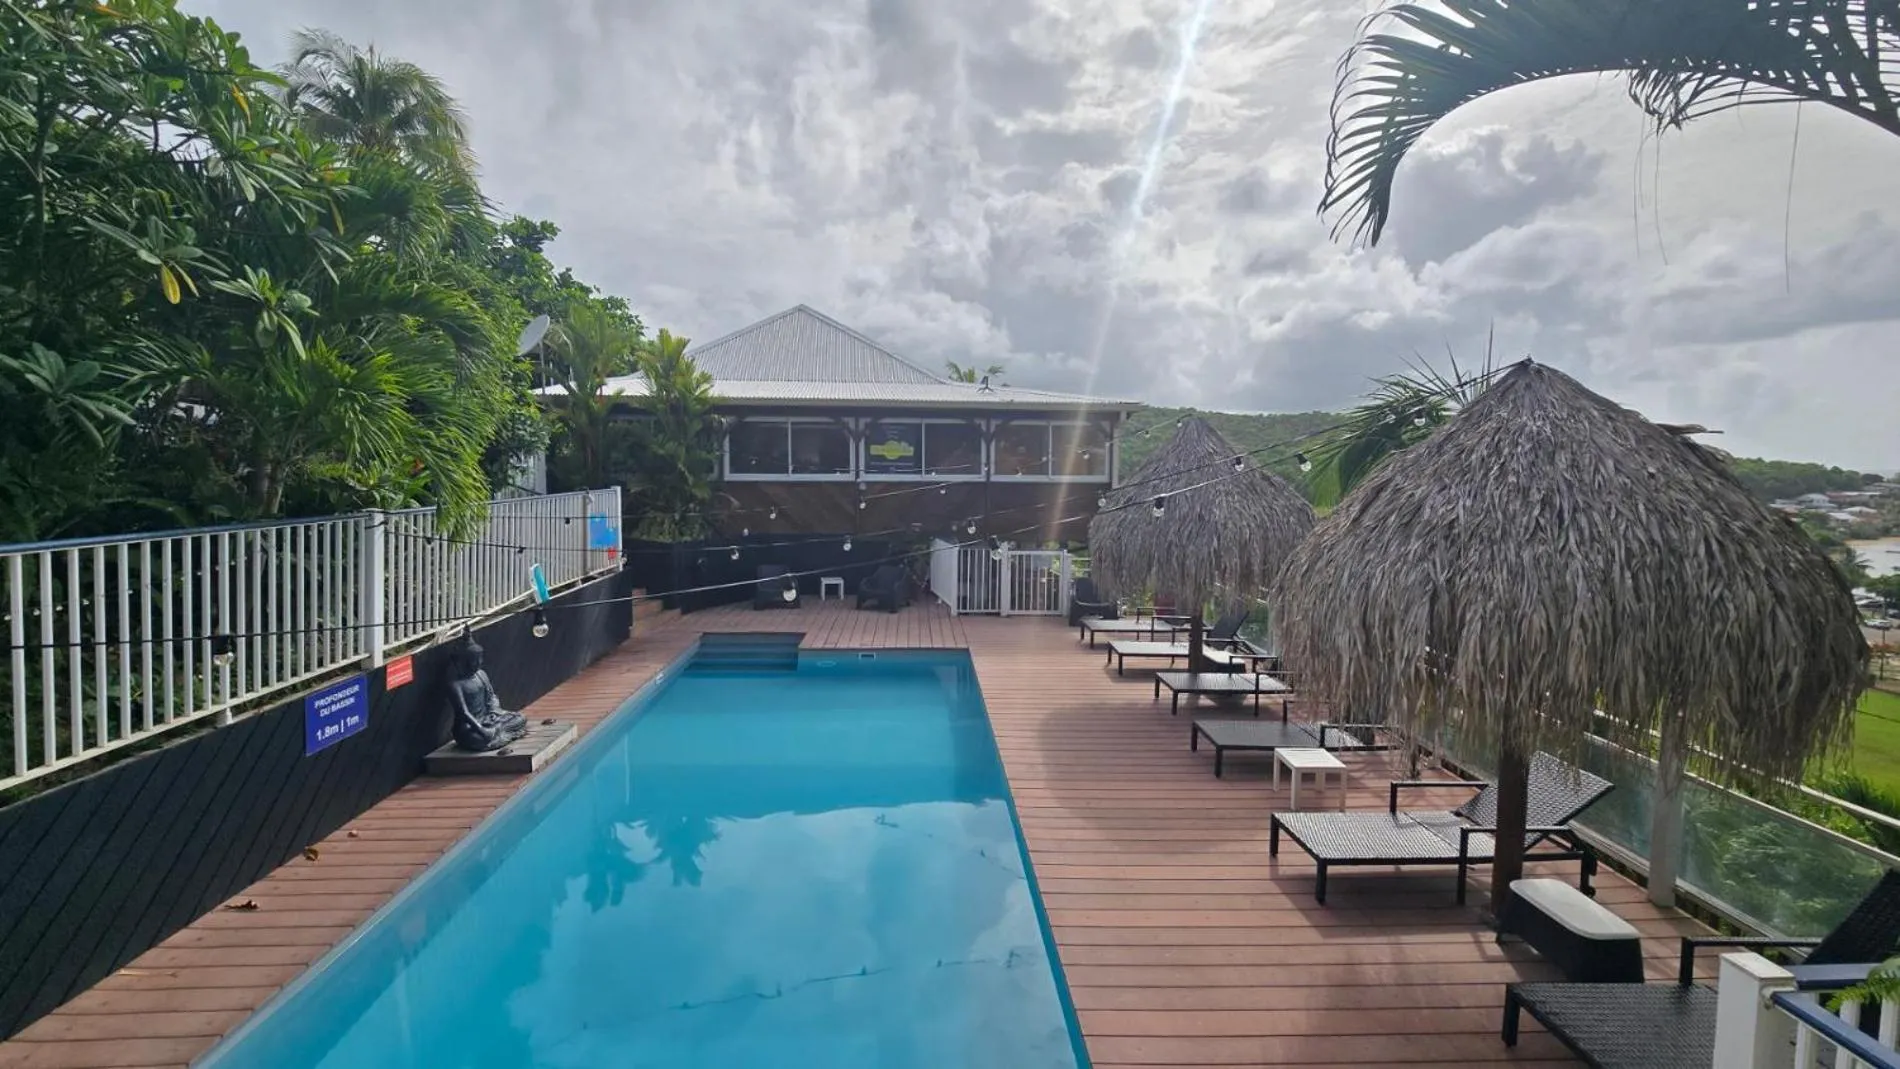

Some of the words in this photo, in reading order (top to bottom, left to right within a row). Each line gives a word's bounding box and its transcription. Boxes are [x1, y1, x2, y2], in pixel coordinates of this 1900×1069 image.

[314, 684, 359, 709] PROFONDEUR
[320, 708, 330, 717] DU
[331, 696, 355, 712] BASSIN
[316, 724, 339, 741] 1.8m
[346, 715, 359, 727] 1m
